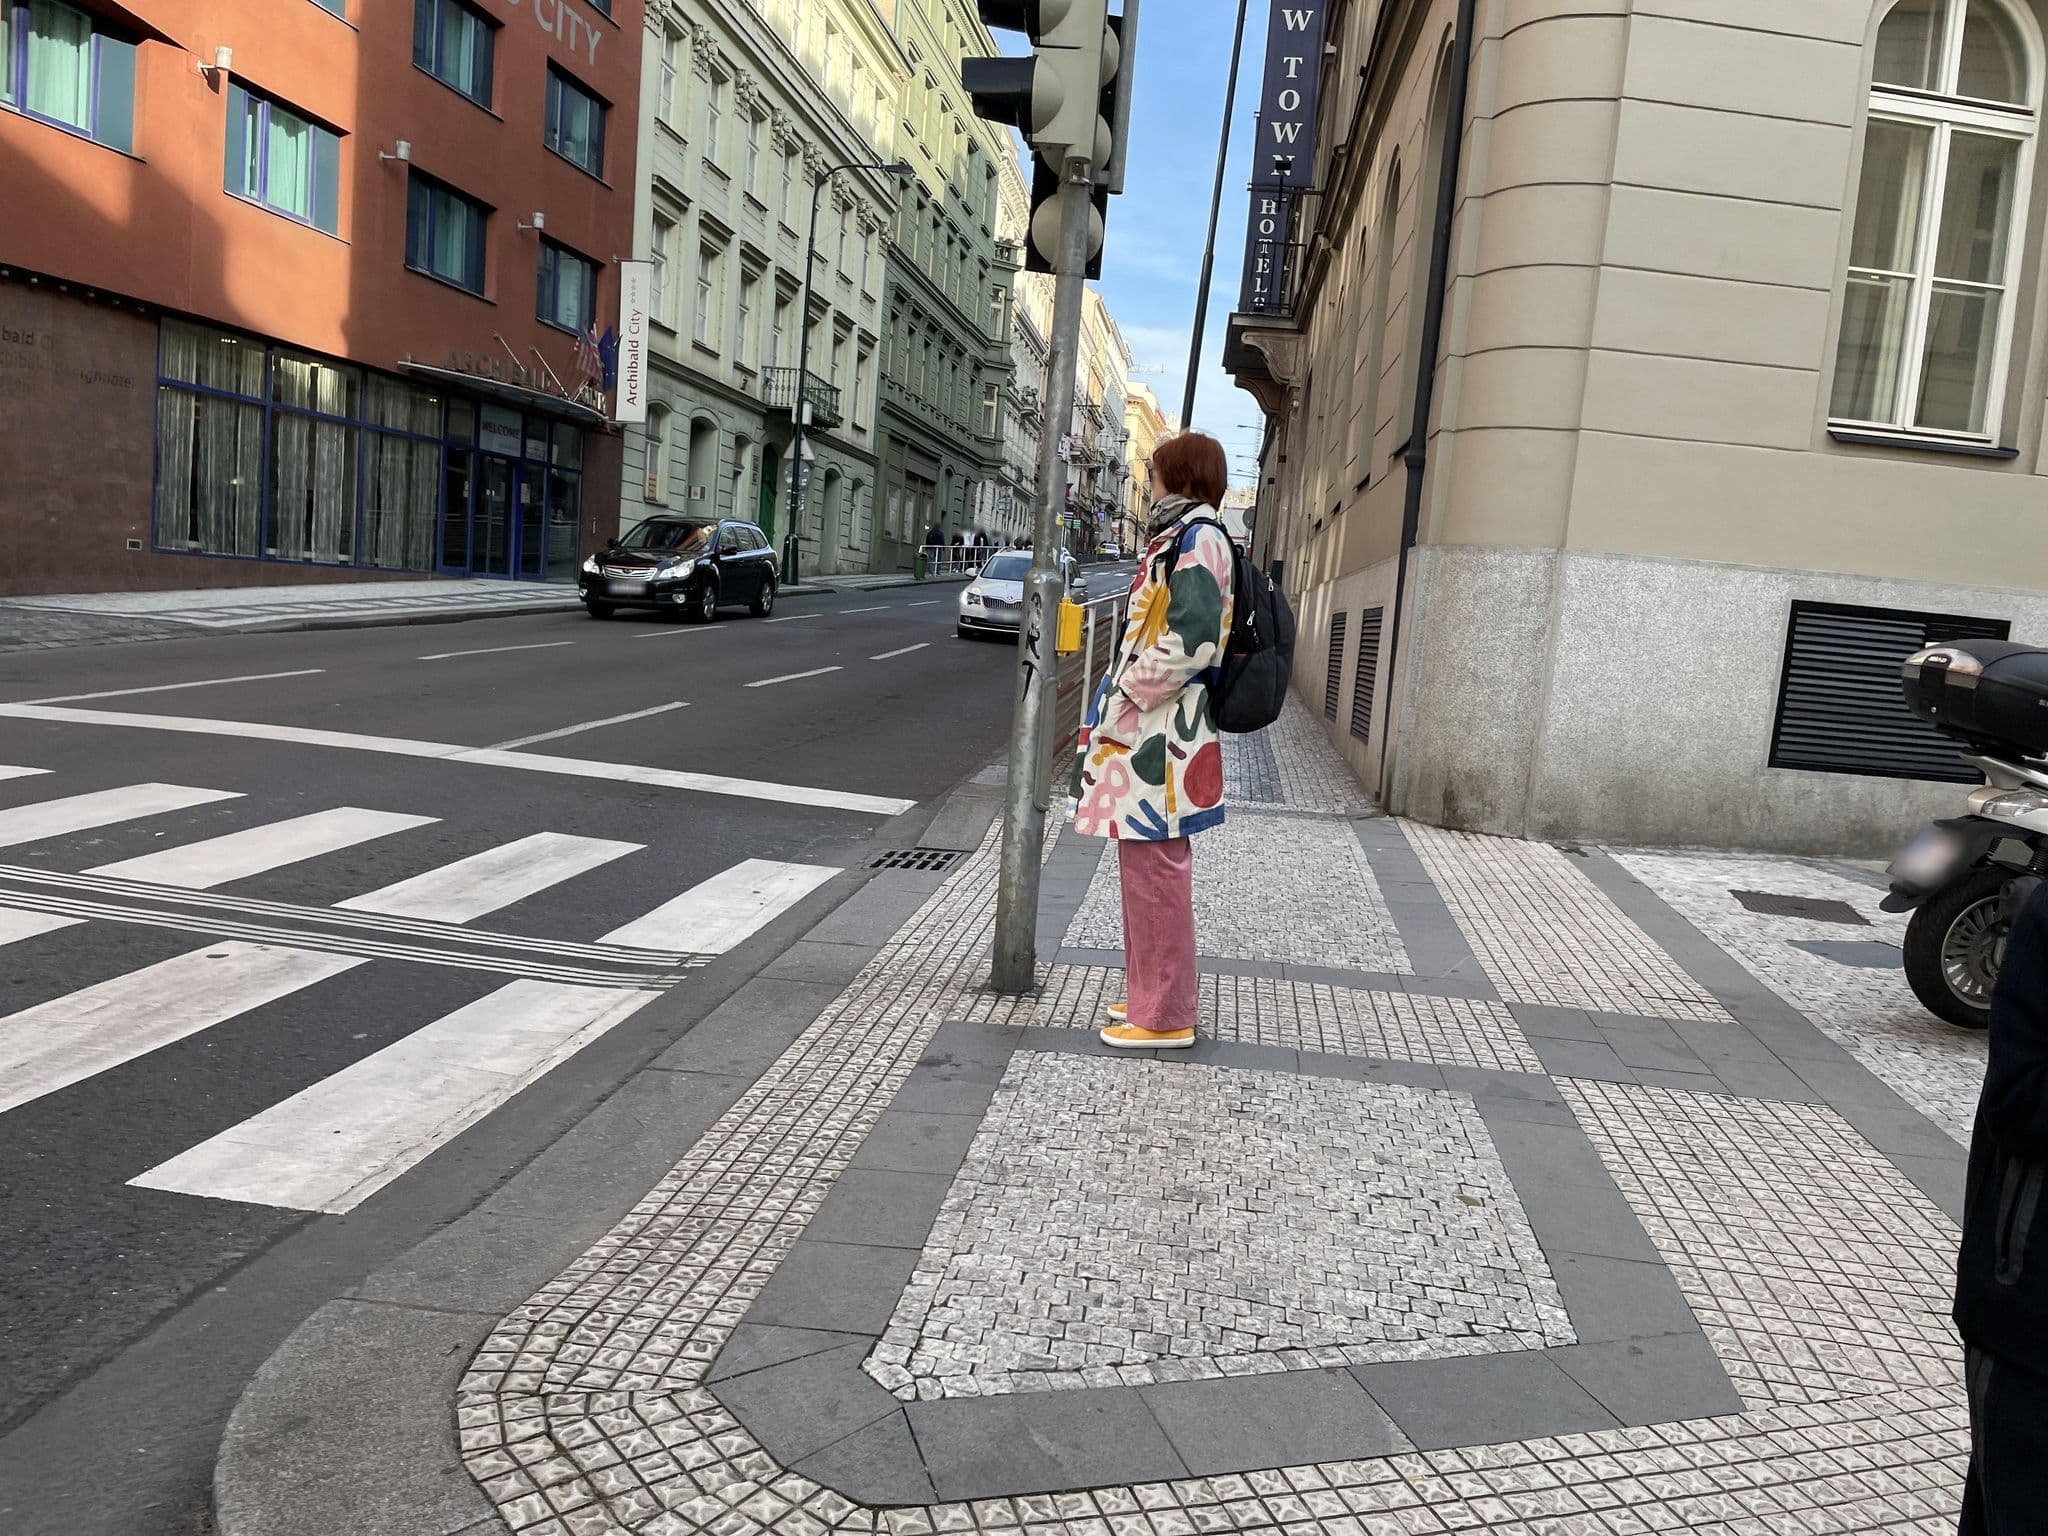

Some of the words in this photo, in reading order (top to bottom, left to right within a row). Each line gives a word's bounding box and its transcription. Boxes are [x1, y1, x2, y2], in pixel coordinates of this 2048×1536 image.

[534, 0, 601, 65] CITY
[1270, 56, 1303, 177] TOWN
[628, 308, 643, 335] City
[626, 340, 640, 406] Archibald
[482, 420, 521, 440] WELCOME
